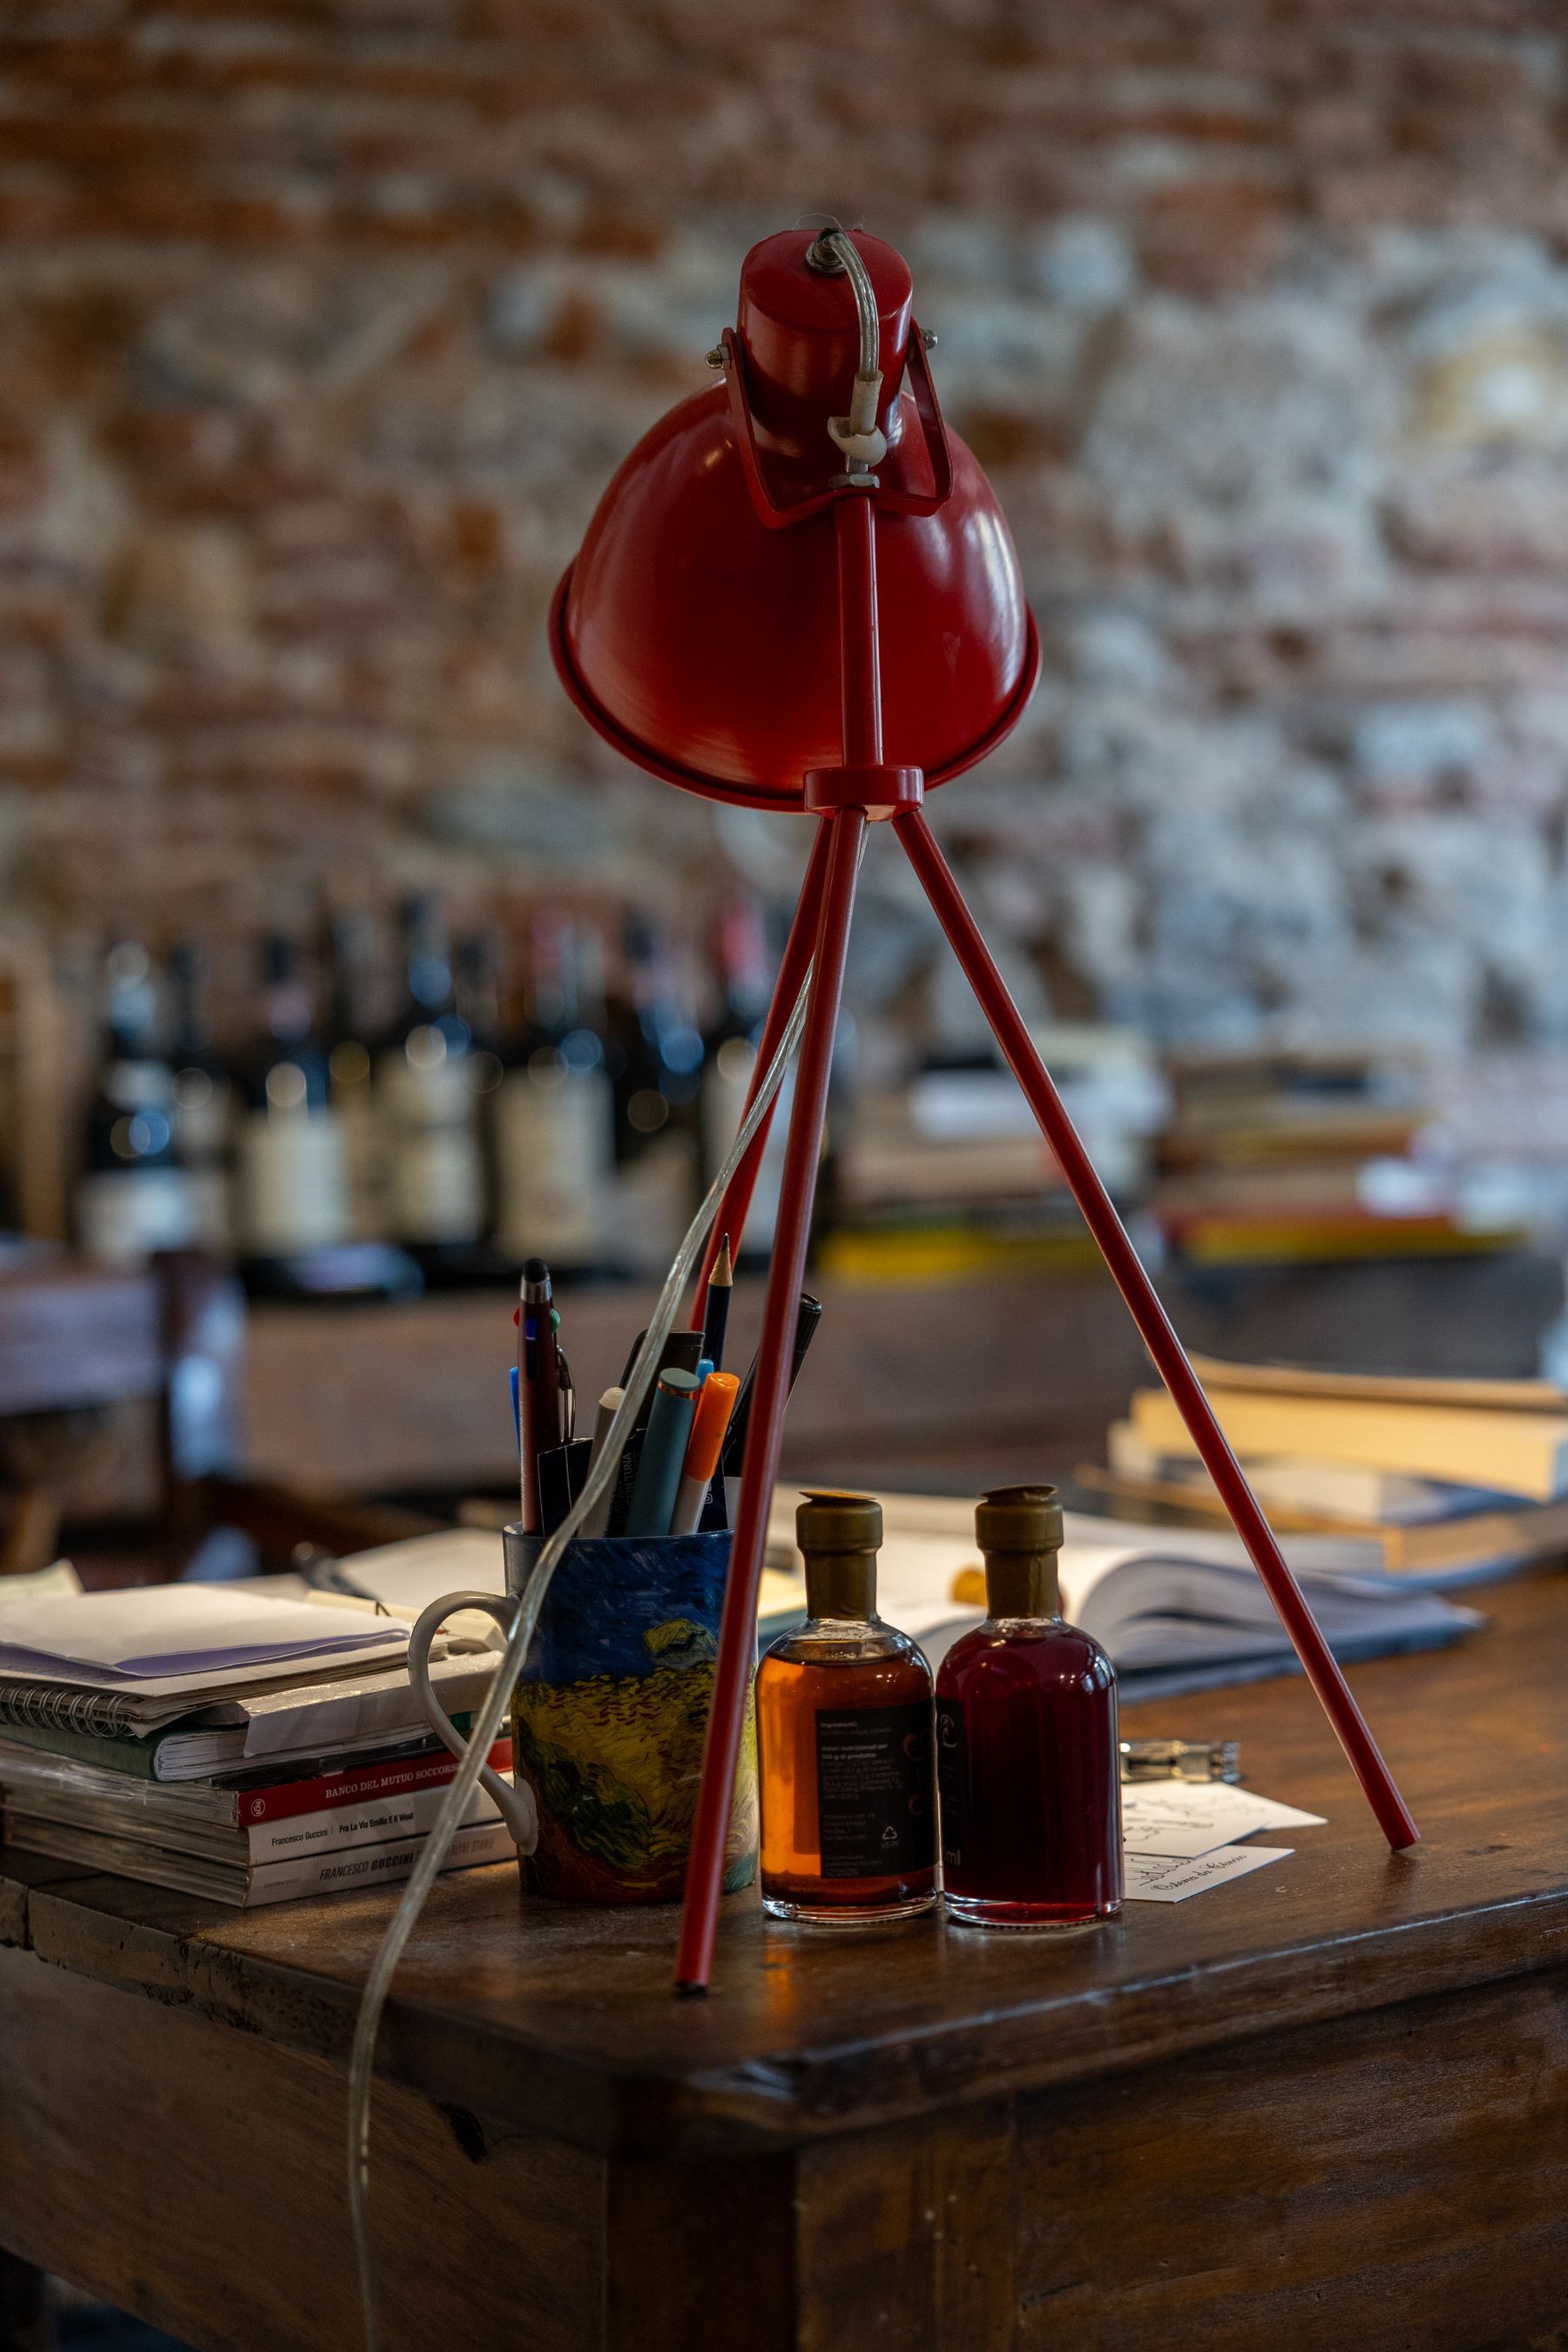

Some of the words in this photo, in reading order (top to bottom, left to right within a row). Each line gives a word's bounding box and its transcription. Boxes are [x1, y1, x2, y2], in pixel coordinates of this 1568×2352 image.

[326, 1783, 358, 1798] BANCO
[360, 1779, 379, 1792] DEL
[381, 1773, 414, 1789] MUTUO
[272, 1834, 303, 1846] Francesco
[305, 1828, 328, 1839] Guccini
[339, 1824, 349, 1833] Fra
[350, 1822, 358, 1831] La
[360, 1820, 368, 1829] Via
[369, 1816, 388, 1828] Emilia
[321, 1861, 368, 1881] FRANCESCO
[371, 1853, 413, 1871] GUCCINI
